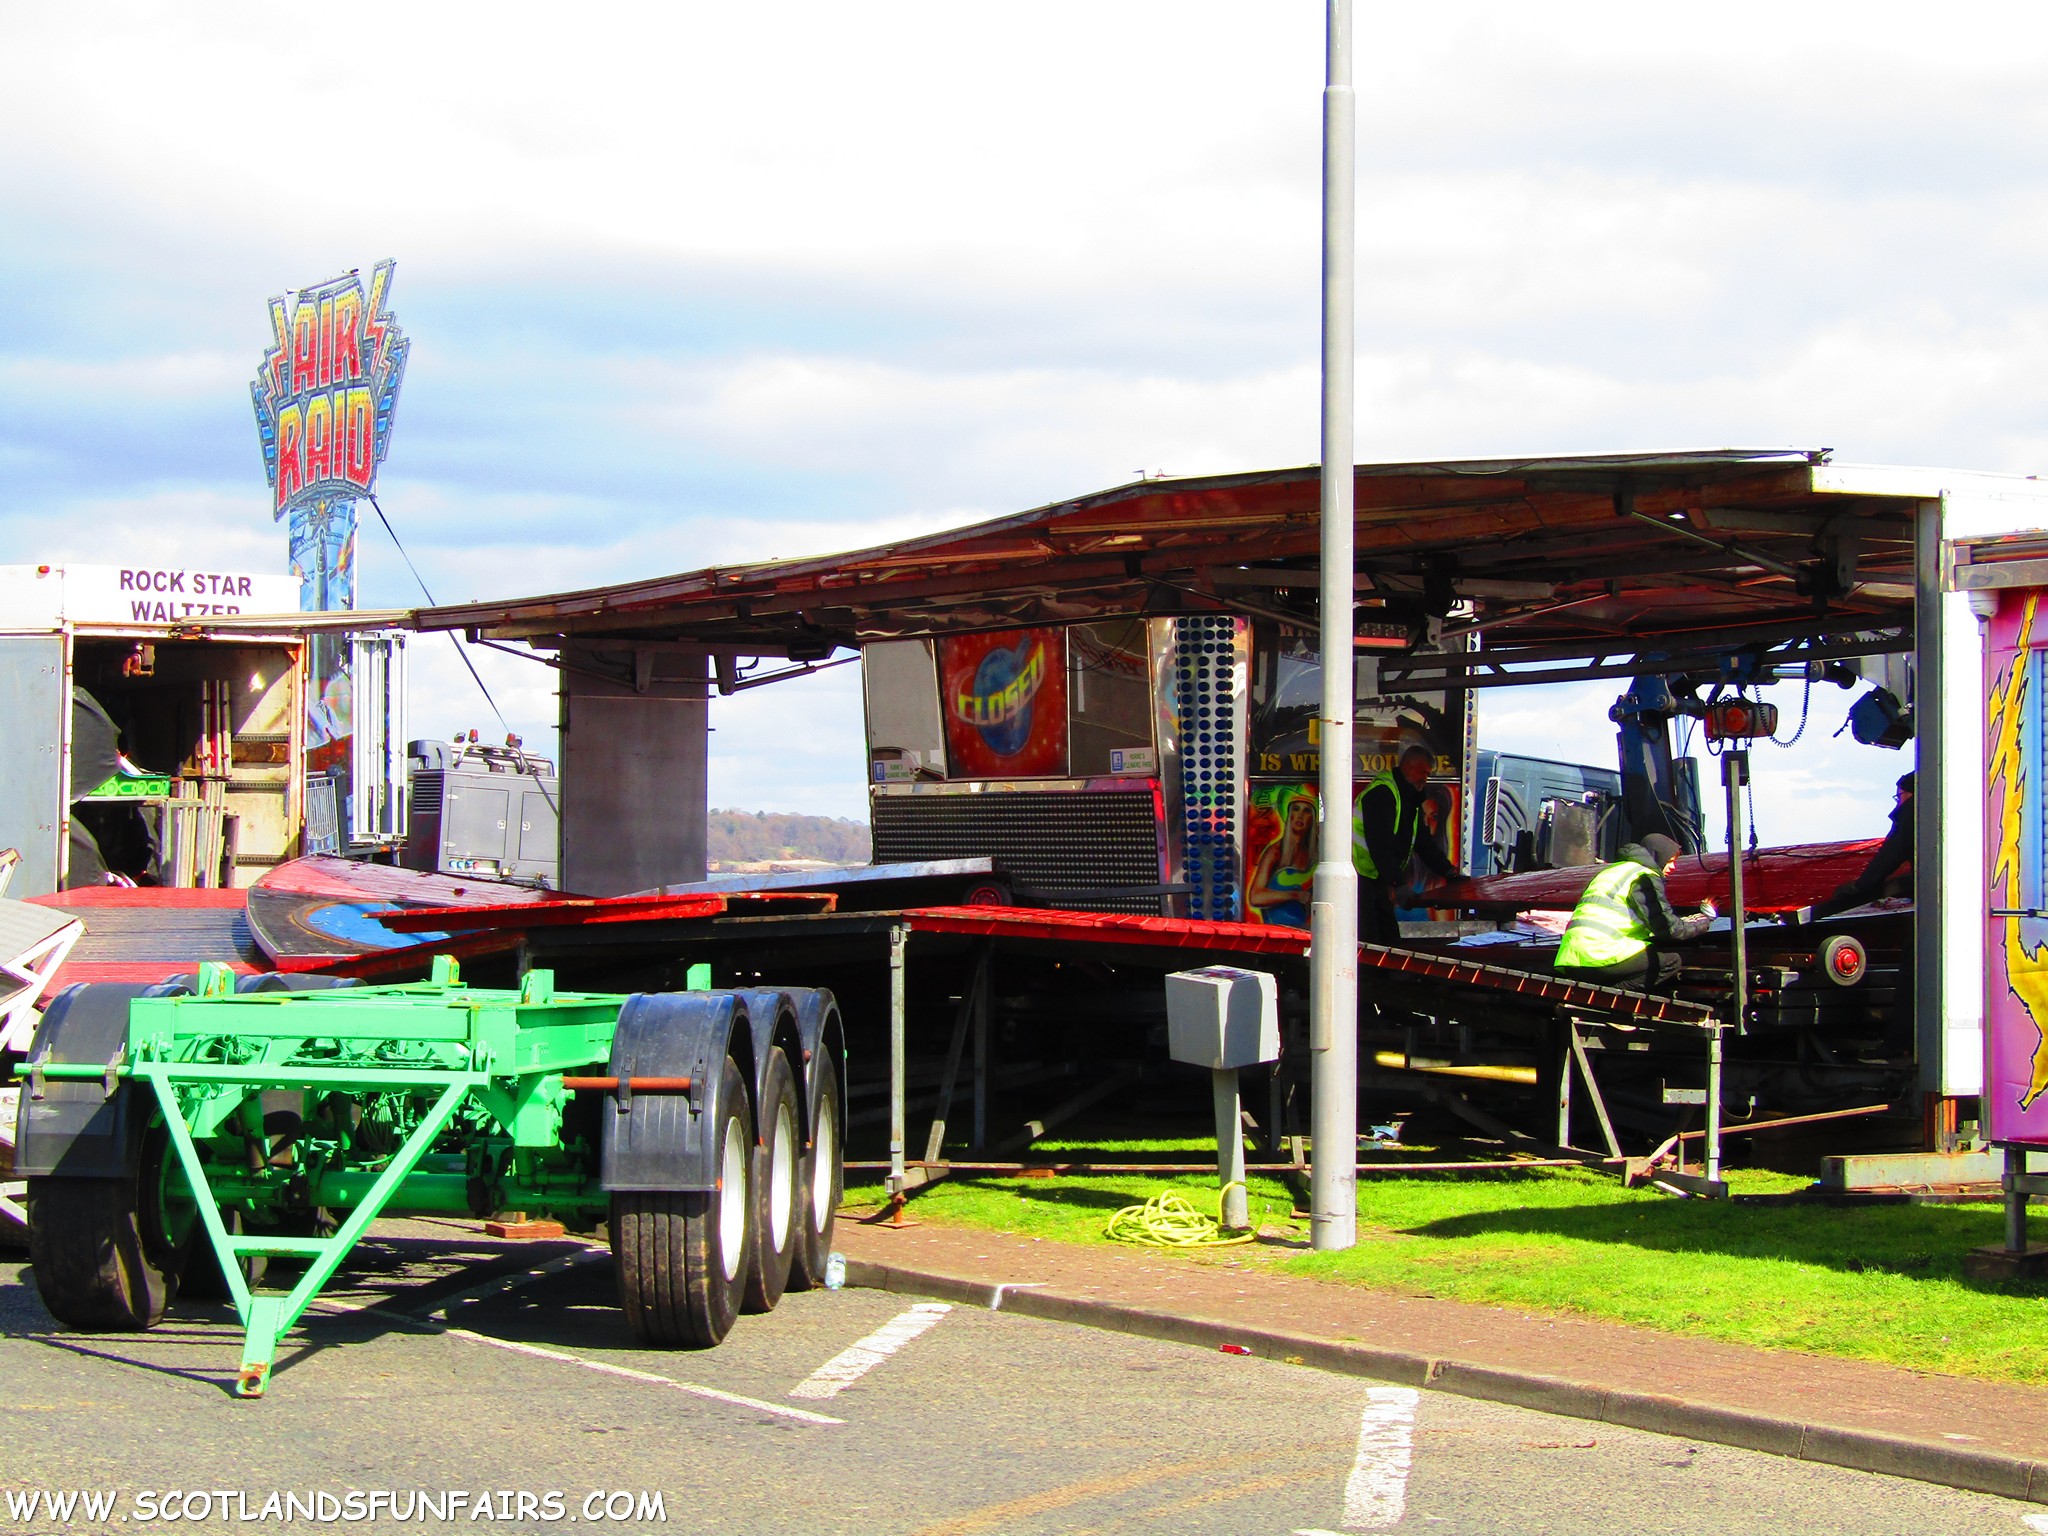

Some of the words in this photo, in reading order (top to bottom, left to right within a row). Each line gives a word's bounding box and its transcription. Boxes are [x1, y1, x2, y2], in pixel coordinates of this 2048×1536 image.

[292, 286, 363, 397] AIR
[276, 386, 374, 509] RAID
[120, 569, 185, 592] ROCK
[193, 573, 252, 597] STAR
[957, 641, 1045, 726] CLOSED
[1260, 752, 1282, 771] IS
